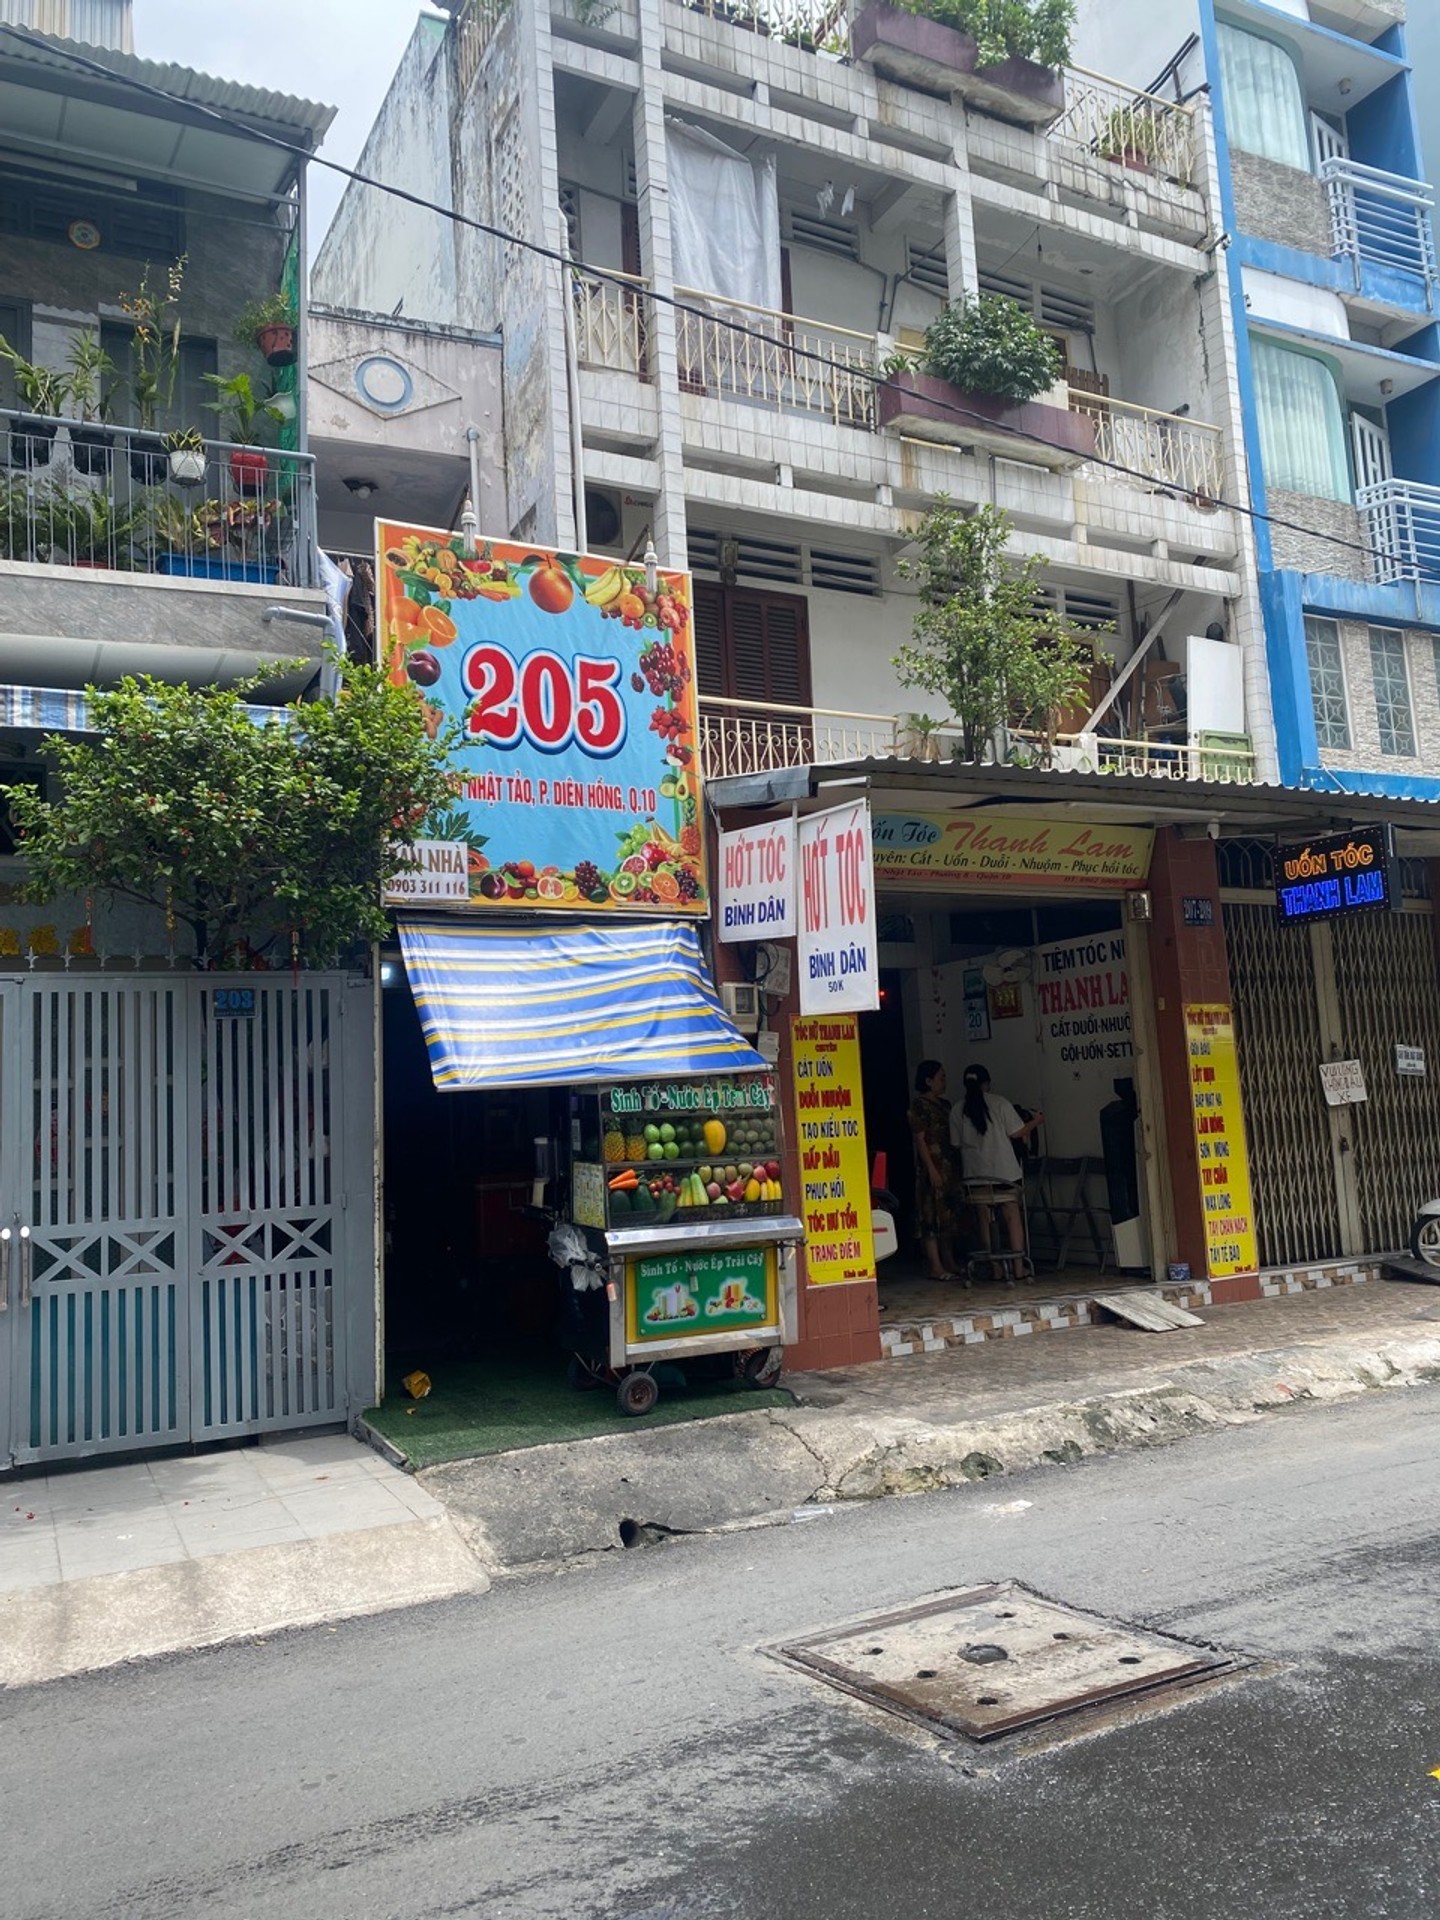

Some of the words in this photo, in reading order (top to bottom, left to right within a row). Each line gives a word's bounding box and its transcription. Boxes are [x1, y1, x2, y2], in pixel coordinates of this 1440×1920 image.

[463, 643, 625, 755] 205
[468, 771, 502, 808] NHẬT
[539, 780, 550, 805] P.
[554, 776, 583, 808] DIÊN
[629, 787, 656, 813] Q.10
[872, 819, 894, 841] ốn
[902, 821, 937, 844] Tóc
[945, 821, 1050, 854] Thanh
[1058, 829, 1134, 859] Lam
[428, 845, 464, 873] NHÀ
[725, 834, 754, 889] HỚT
[758, 827, 786, 884] TÓC
[836, 809, 866, 926] TÓC
[873, 850, 906, 866] uyên:
[910, 850, 931, 866] Cắt
[943, 852, 968, 867] Uốn
[1019, 856, 1061, 872] Nhuộm
[1071, 859, 1099, 875] Phục
[1122, 861, 1139, 875] tóc
[1284, 848, 1327, 881] UỐN
[1330, 842, 1374, 871] TÓC
[388, 879, 416, 893] 0903
[420, 880, 439, 894] 311
[446, 881, 465, 895] 116
[1281, 879, 1341, 916] THANH
[1344, 870, 1383, 905] LAM
[725, 898, 754, 926] BÌNH
[757, 895, 785, 923] DÂN
[809, 948, 835, 979] BÌNH
[840, 942, 867, 974] DÂN
[1042, 947, 1075, 974] TIỆM
[1076, 940, 1106, 966] TÓC
[828, 979, 844, 993] 50K
[1039, 974, 1104, 1014] THANH
[1105, 971, 1129, 1006] LA
[969, 1012, 982, 1028] 20
[797, 1053, 813, 1078] CẮT
[816, 1054, 834, 1077] UỐN
[611, 1087, 641, 1112] Sinh
[703, 1083, 720, 1113] Ép
[750, 1082, 771, 1111] Cây
[801, 1122, 819, 1142] TẠO
[820, 1112, 840, 1138] KIỂU
[842, 1116, 858, 1137] TÓC
[805, 1182, 828, 1202] PHỤC
[807, 1209, 825, 1233] TÓC
[810, 1243, 837, 1262] TRANG
[840, 1233, 861, 1259] ĐIỂM
[640, 1263, 663, 1277] Sinh
[665, 1260, 678, 1275] Tố
[685, 1259, 709, 1273] Nước
[711, 1254, 723, 1271] Ép
[725, 1255, 745, 1268] Trái
[747, 1252, 764, 1266] Cây
